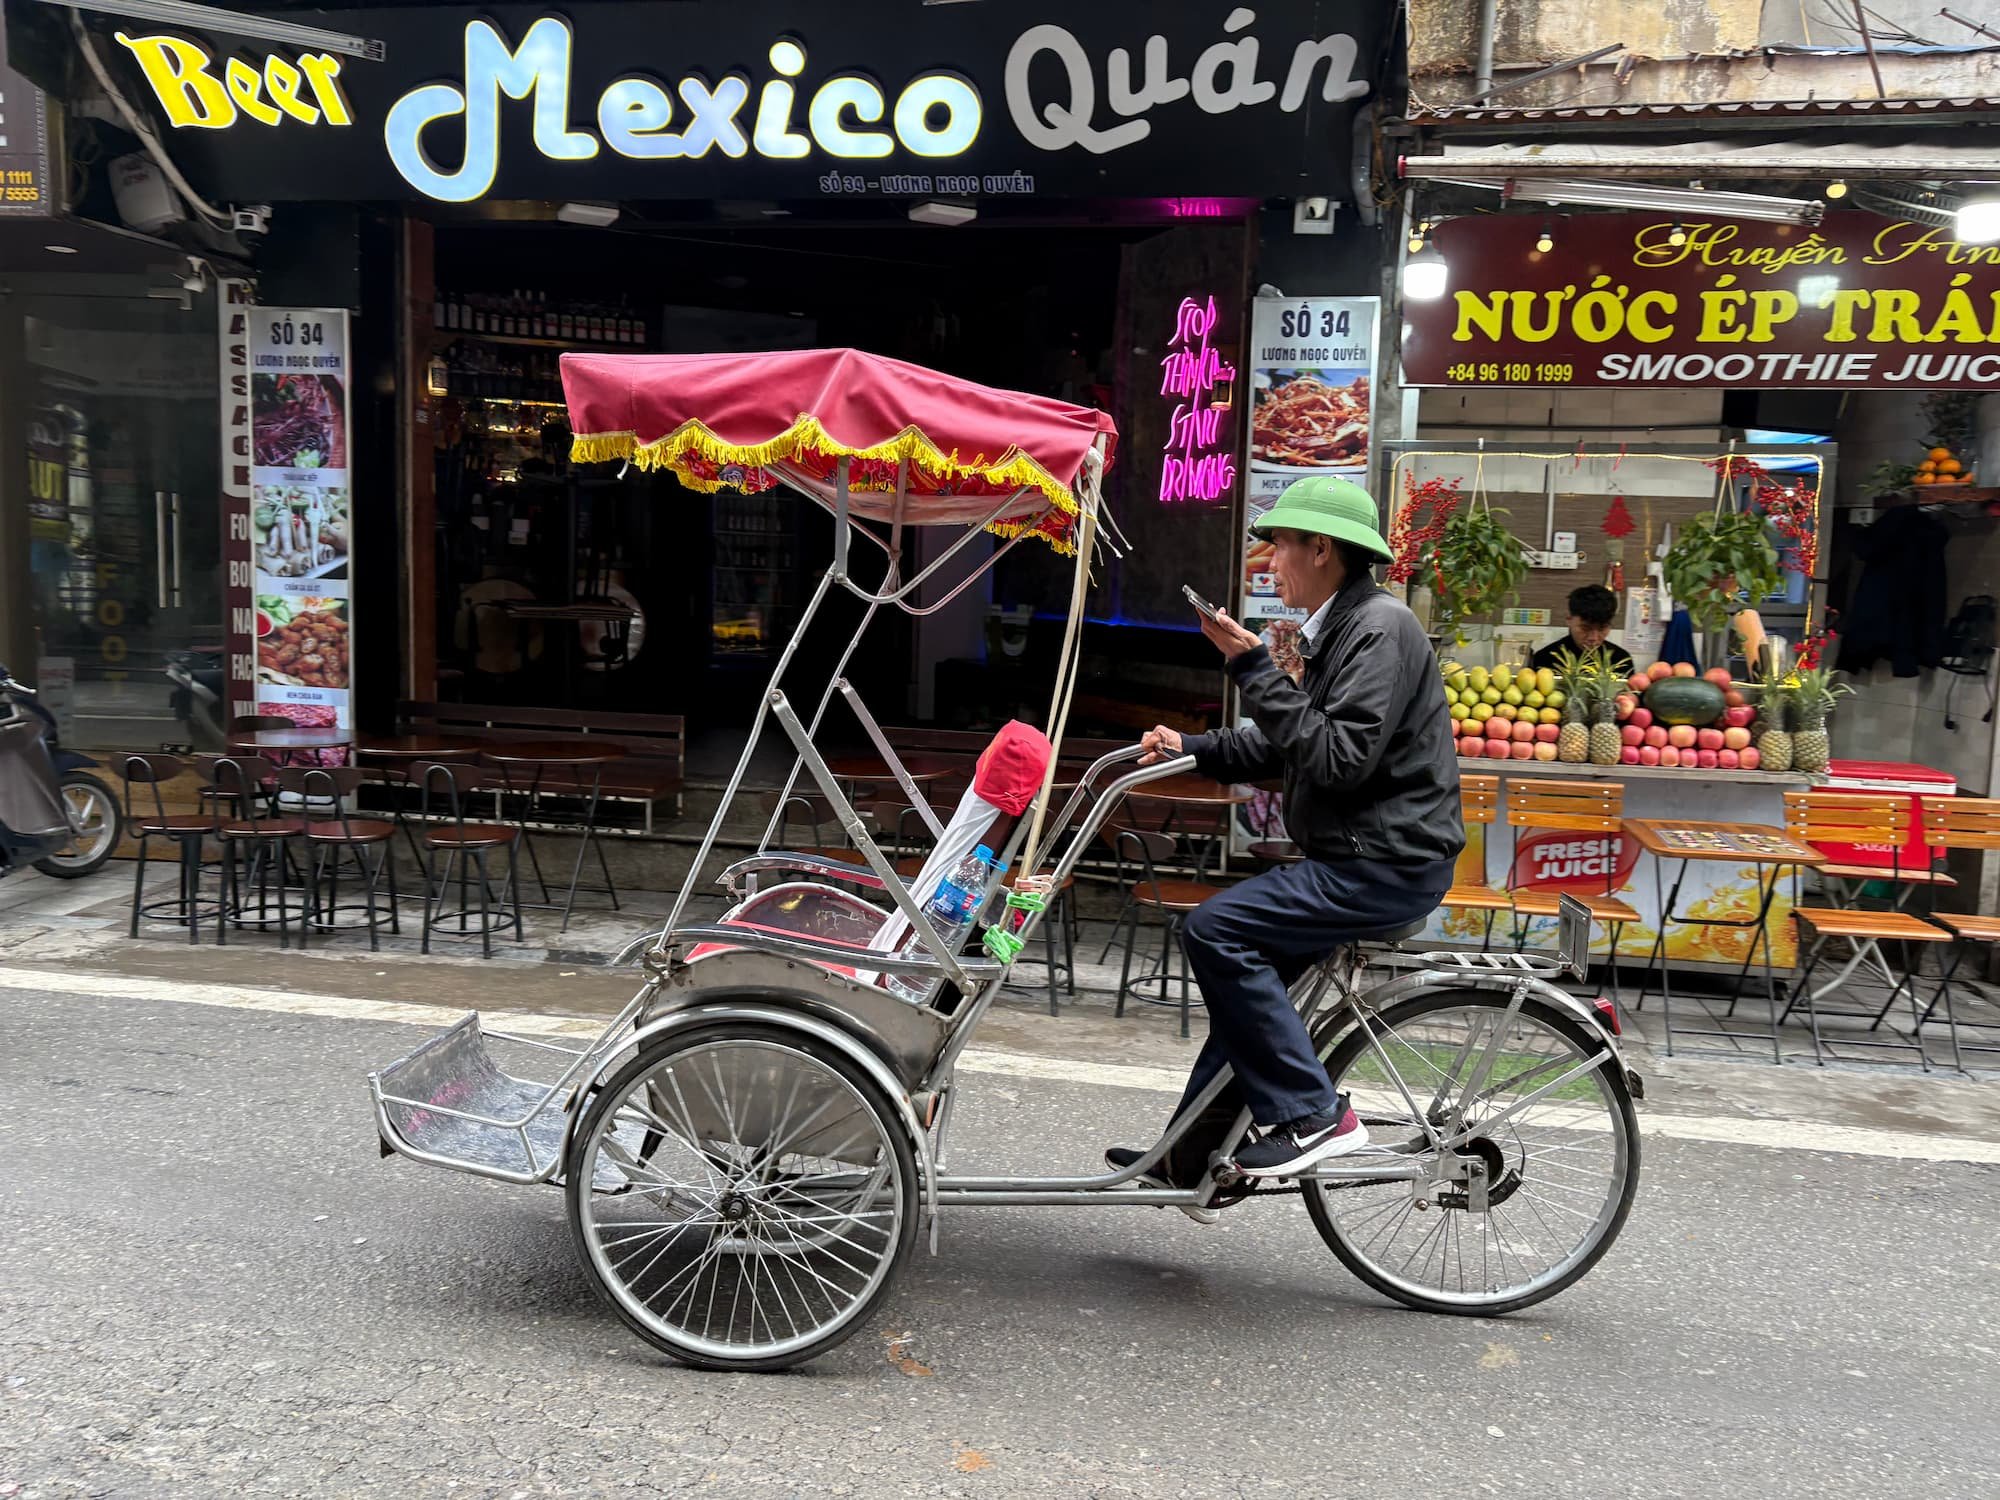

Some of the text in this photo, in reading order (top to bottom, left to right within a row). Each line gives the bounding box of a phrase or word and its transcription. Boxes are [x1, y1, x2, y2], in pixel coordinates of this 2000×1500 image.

[114, 31, 352, 129] Beer
[384, 7, 1370, 203] Mexico Quán
[819, 170, 843, 193] SỐ
[844, 176, 865, 193] 34
[880, 175, 932, 193] LƯƠNG
[936, 176, 979, 196] NGỌC
[1633, 223, 1849, 275] Huyền
[1167, 295, 1217, 345] STOP
[1280, 301, 1350, 338] SỐ 34
[1452, 275, 1678, 343] NƯỚC
[1695, 274, 1800, 343] ÉP
[271, 312, 323, 345] SỐ 34
[1262, 347, 1297, 361] LƯƠNG
[1300, 347, 1329, 364] NGỌC
[1447, 363, 1574, 382] +84 96 180 1999
[1596, 353, 1878, 381] SMOOTHIE
[1163, 403, 1222, 450] START
[1532, 838, 1622, 862] FRESH
[1534, 857, 1617, 879] JUICE
